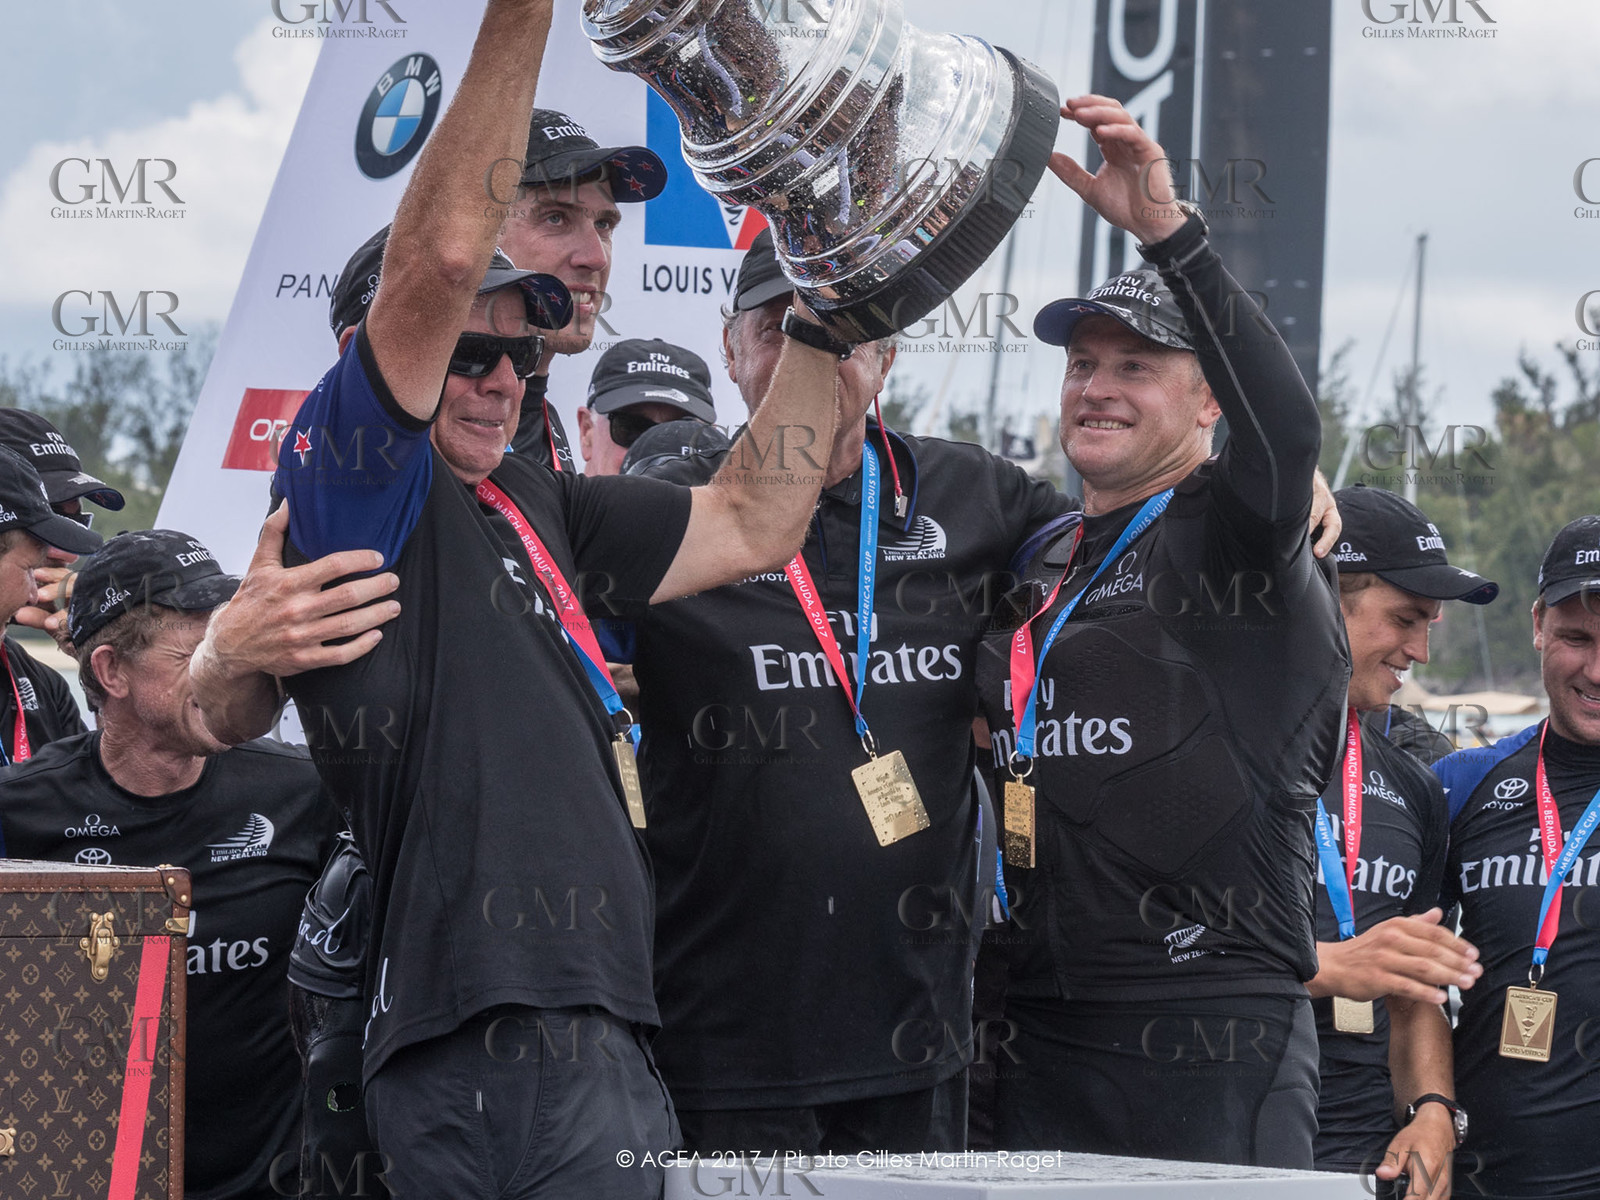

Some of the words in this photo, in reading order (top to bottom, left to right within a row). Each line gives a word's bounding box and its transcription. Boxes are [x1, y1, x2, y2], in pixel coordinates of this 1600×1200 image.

[376, 55, 442, 98] BMW
[642, 263, 713, 295] LOUIS
[1117, 275, 1141, 287] Fly
[1088, 282, 1162, 307] Emirates
[626, 360, 691, 380] Emirates
[649, 352, 671, 363] Fly
[867, 480, 876, 510] LOUIS
[1126, 516, 1152, 544] LOUIS
[476, 483, 497, 503] CUP
[493, 501, 523, 531] MATCH
[554, 583, 575, 612] 2017
[906, 552, 946, 561] ZEALAND
[864, 551, 873, 573] CUP
[99, 589, 132, 614] OMEGA
[788, 557, 815, 610] BERMUDA,
[811, 611, 829, 638] 2017
[1085, 572, 1143, 606] OMEGA
[861, 576, 873, 634] AMERICA'S
[1016, 627, 1027, 655] 2017
[1347, 747, 1358, 778] MATCH
[64, 824, 122, 839] OMEGA
[1347, 828, 1355, 853] 2017
[1556, 828, 1587, 878] AMERICA'S
[1583, 810, 1599, 830] CUP
[210, 855, 230, 863] NEW
[230, 850, 268, 861] ZEALAND
[1170, 952, 1191, 965] NEW
